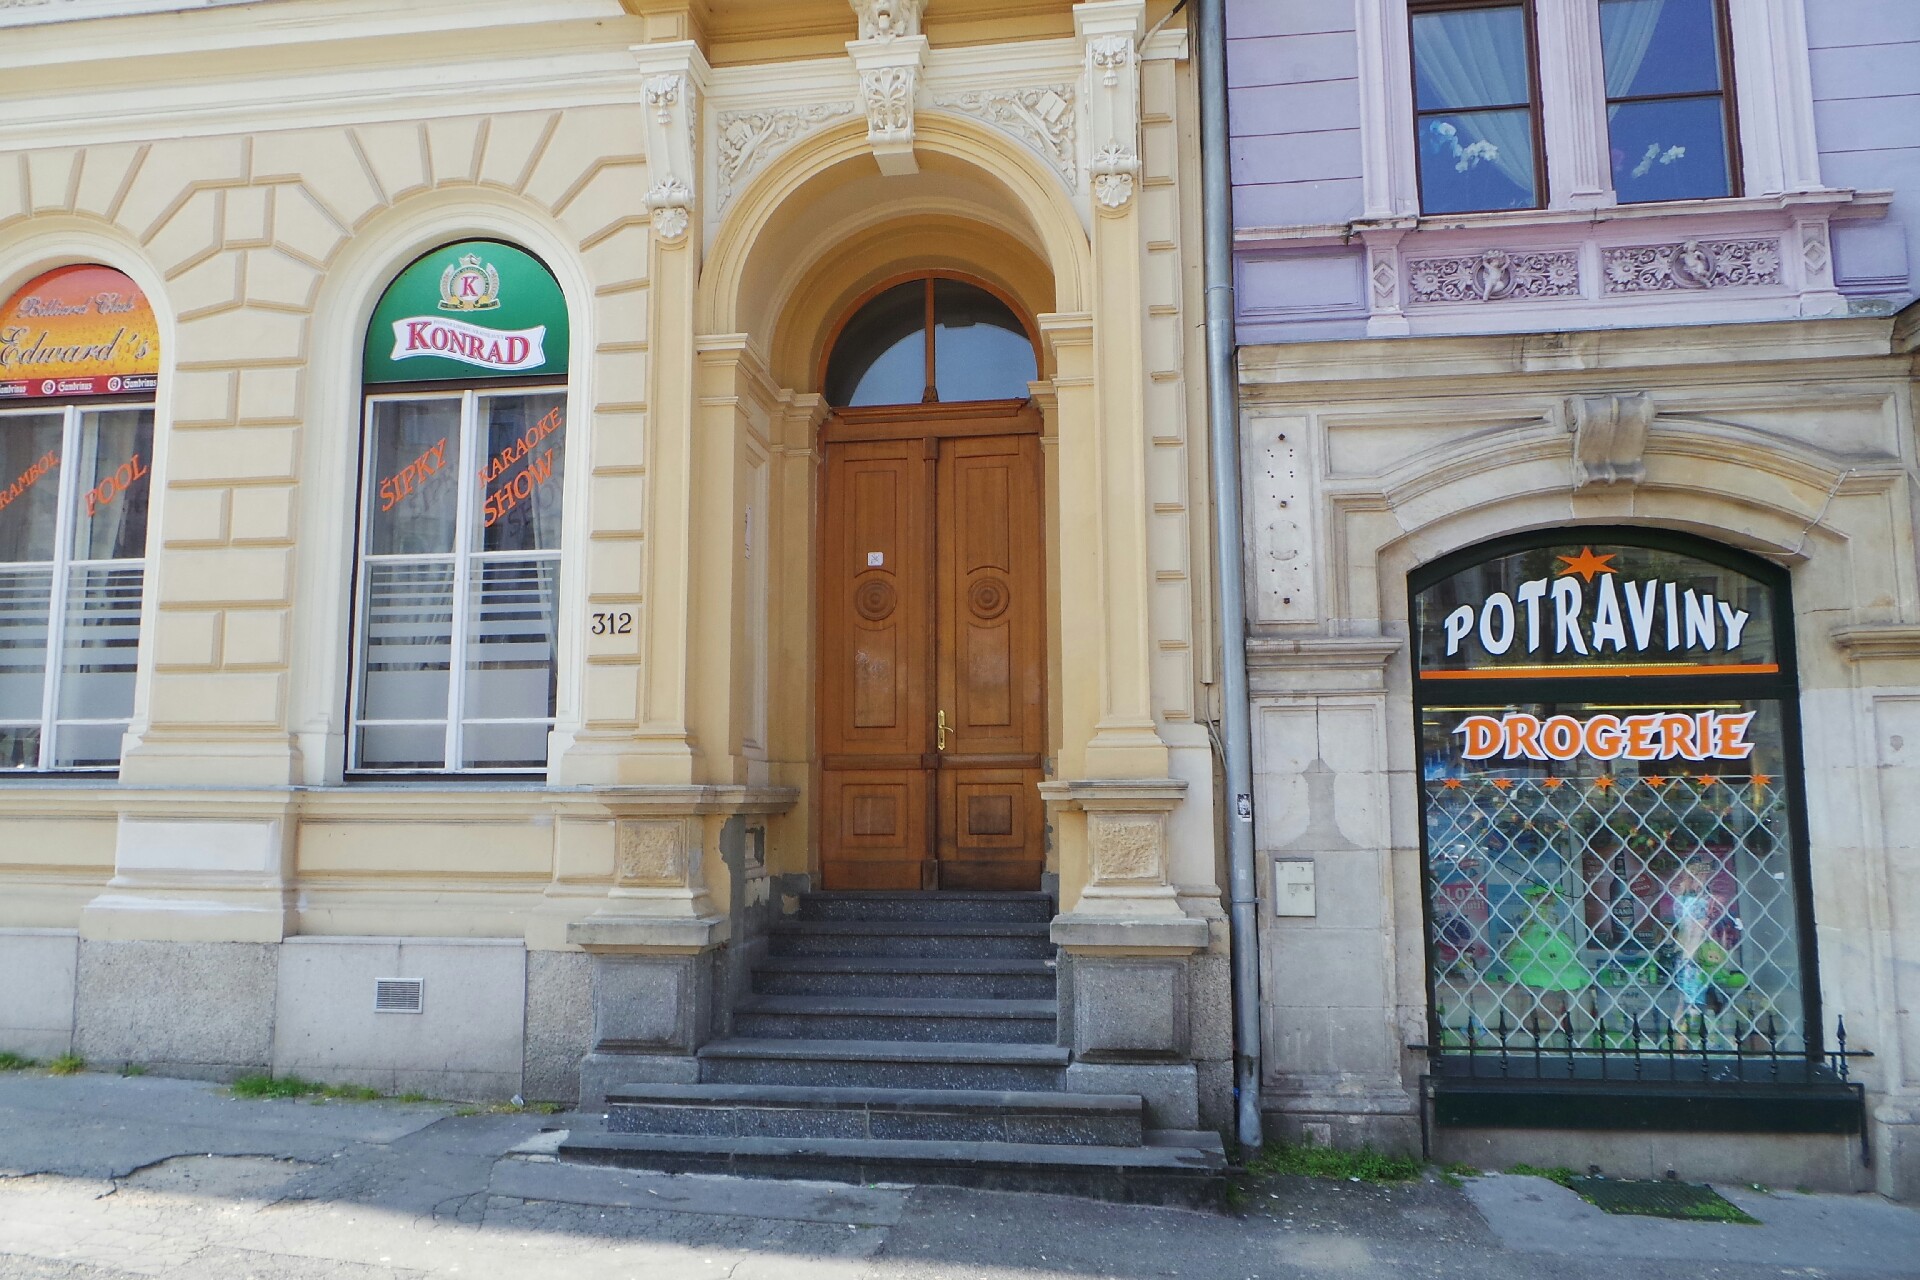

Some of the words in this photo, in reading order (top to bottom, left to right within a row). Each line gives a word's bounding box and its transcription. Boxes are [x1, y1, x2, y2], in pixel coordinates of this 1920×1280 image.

[16, 295, 94, 319] Billiard
[94, 292, 137, 315] Club
[405, 321, 531, 365] KONRAD
[58, 381, 92, 392] Gambrinus
[123, 378, 157, 389] Gambrinus
[478, 406, 562, 490] KARAOKE
[84, 454, 150, 517] POOL
[379, 437, 448, 512] ŠIPKY
[482, 448, 554, 528] SHOW
[591, 612, 632, 635] 312
[1443, 573, 1750, 656] POTRAVINY
[1452, 709, 1757, 761] DROGERIE
